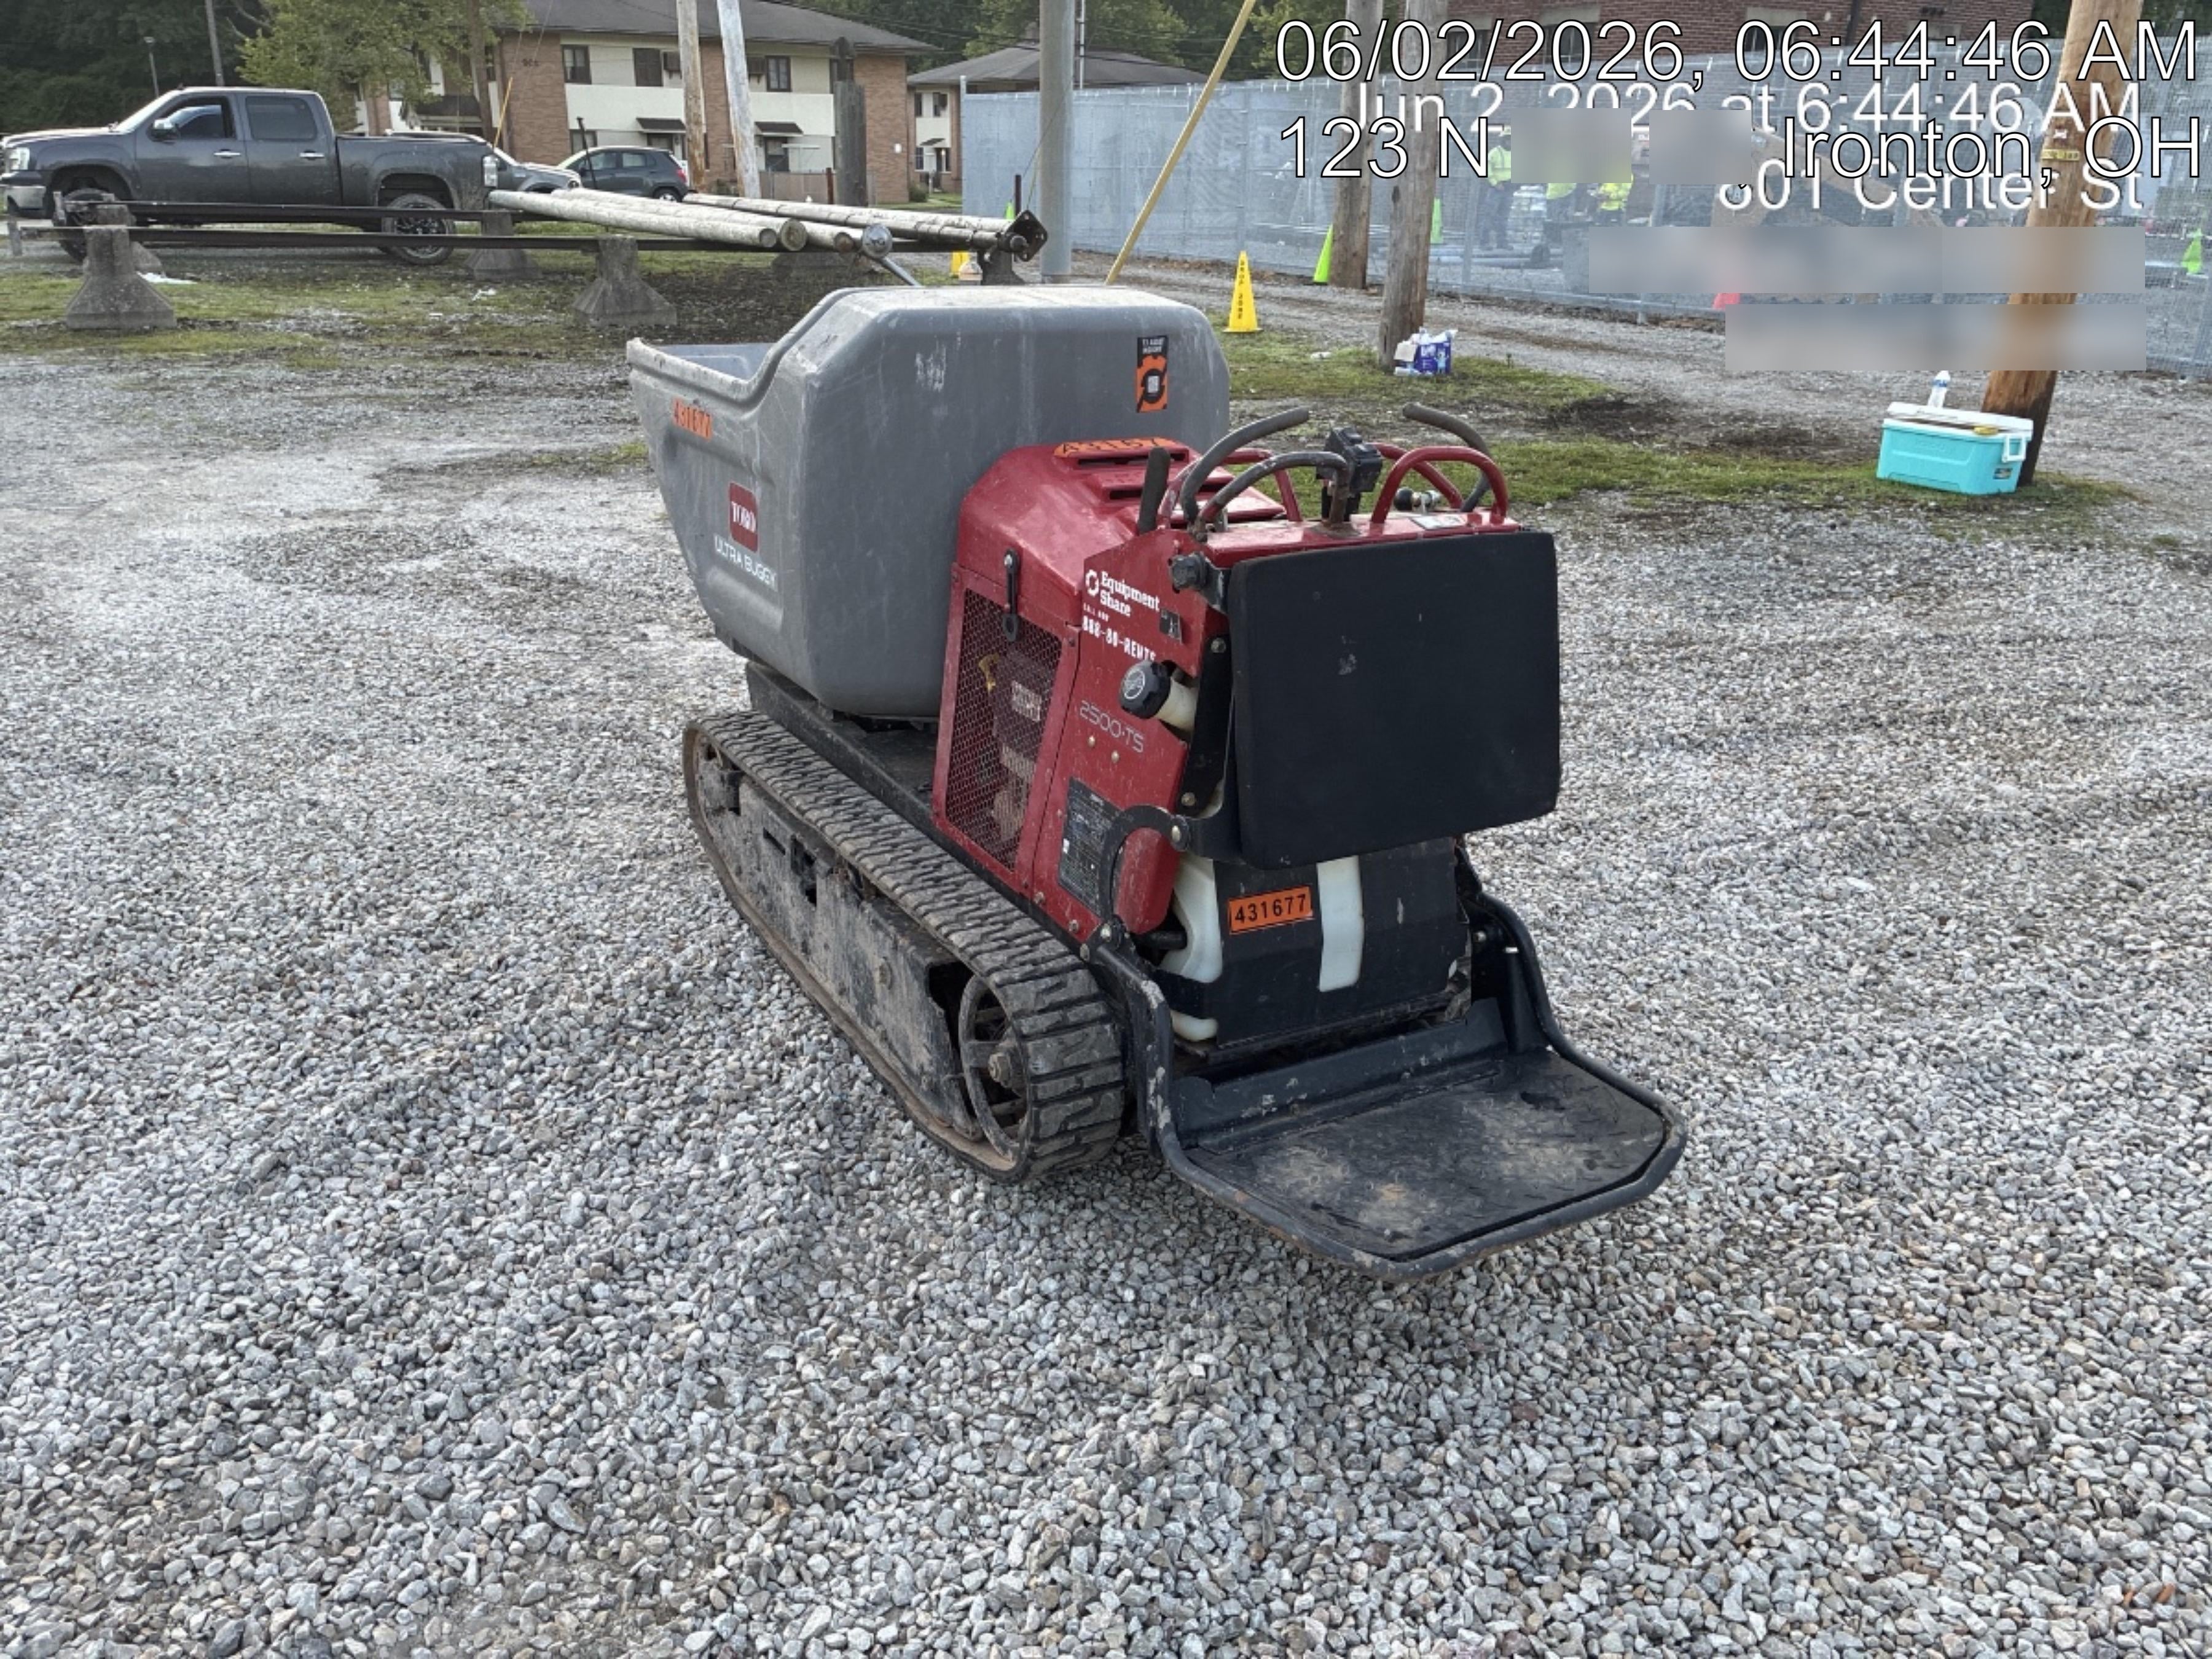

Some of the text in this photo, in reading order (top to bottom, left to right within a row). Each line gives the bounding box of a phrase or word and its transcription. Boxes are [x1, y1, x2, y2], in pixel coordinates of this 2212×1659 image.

[731, 501, 758, 533] TORO
[713, 533, 742, 569] ULTRA
[1099, 589, 1132, 617] Share
[1100, 570, 1160, 612] Equipment
[1234, 893, 1306, 924] 431677
